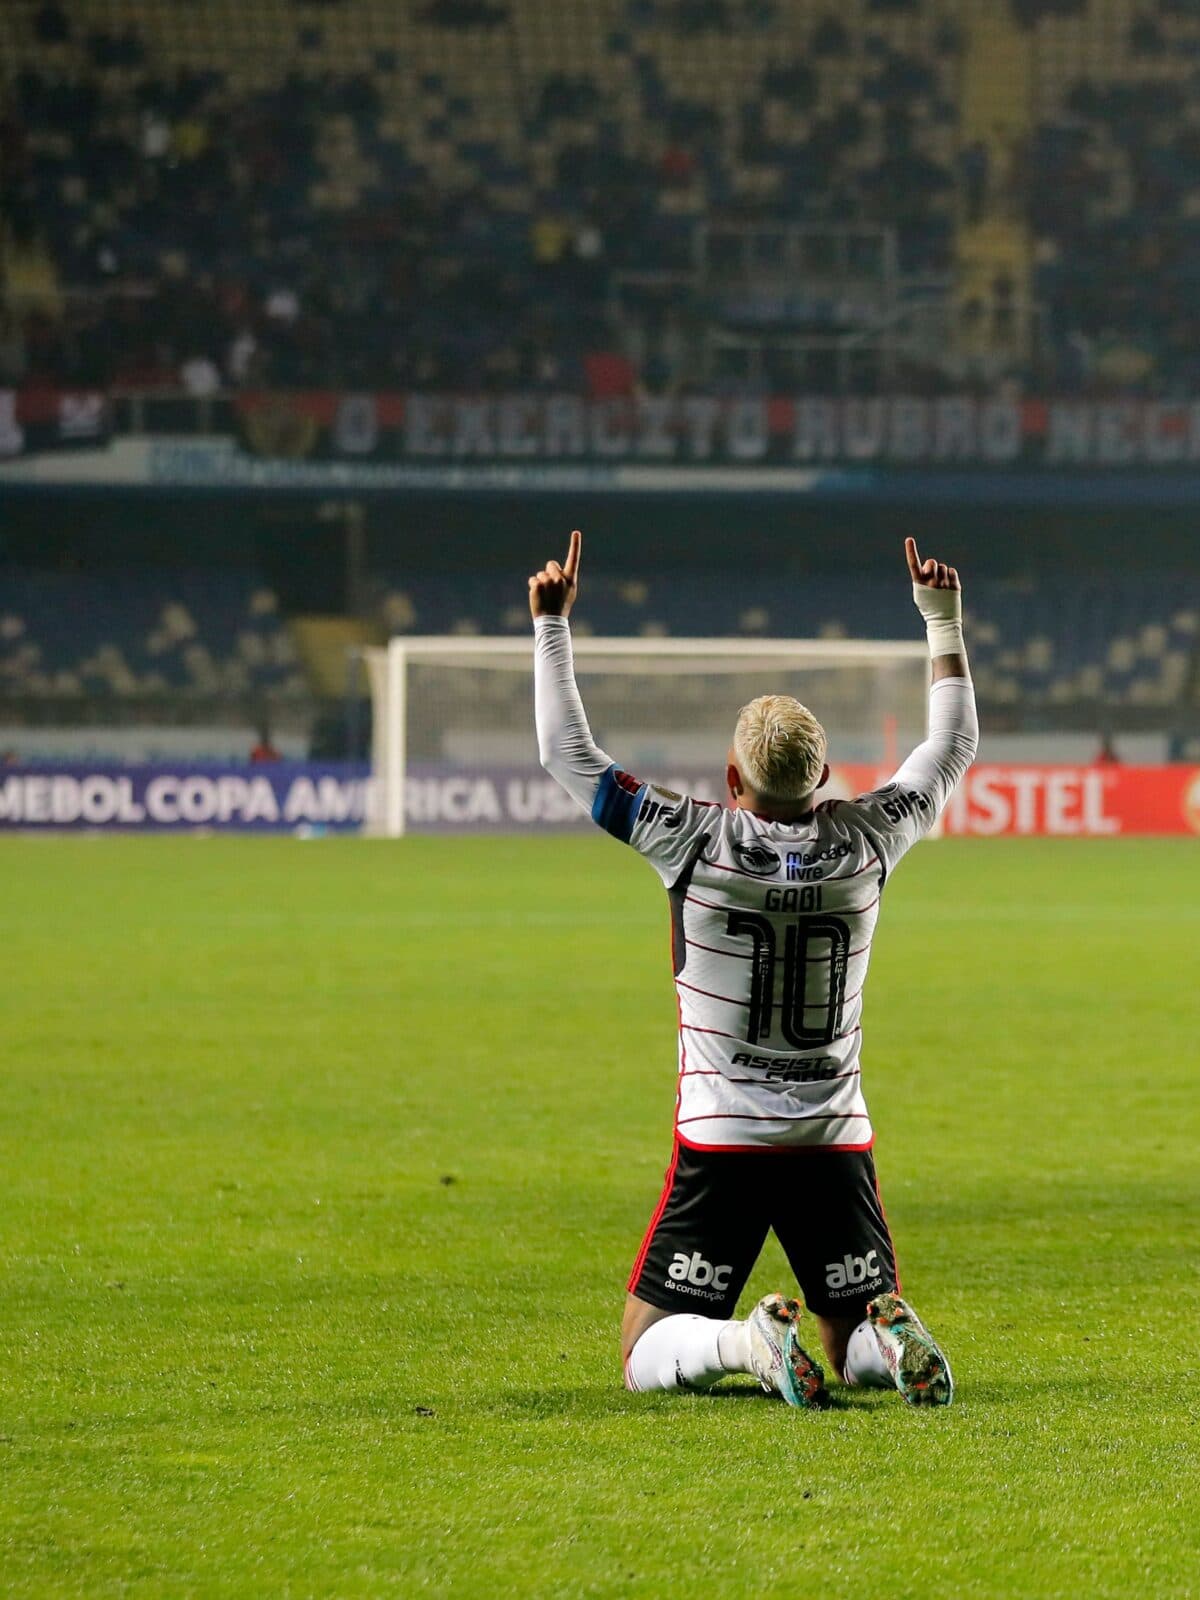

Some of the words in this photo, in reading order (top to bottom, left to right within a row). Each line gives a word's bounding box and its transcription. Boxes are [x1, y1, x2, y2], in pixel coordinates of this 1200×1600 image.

[794, 399, 1018, 459] RUBRO
[146, 774, 280, 823] COPA
[786, 864, 823, 881] livre
[765, 884, 822, 913] GABI
[726, 911, 851, 1050] 10
[731, 1053, 832, 1073] ASSIST
[667, 1251, 734, 1292] abc
[825, 1250, 881, 1290] abc
[664, 1279, 677, 1290] da
[676, 1282, 726, 1302] construção
[828, 1289, 841, 1299] da
[840, 1277, 883, 1297] construção
